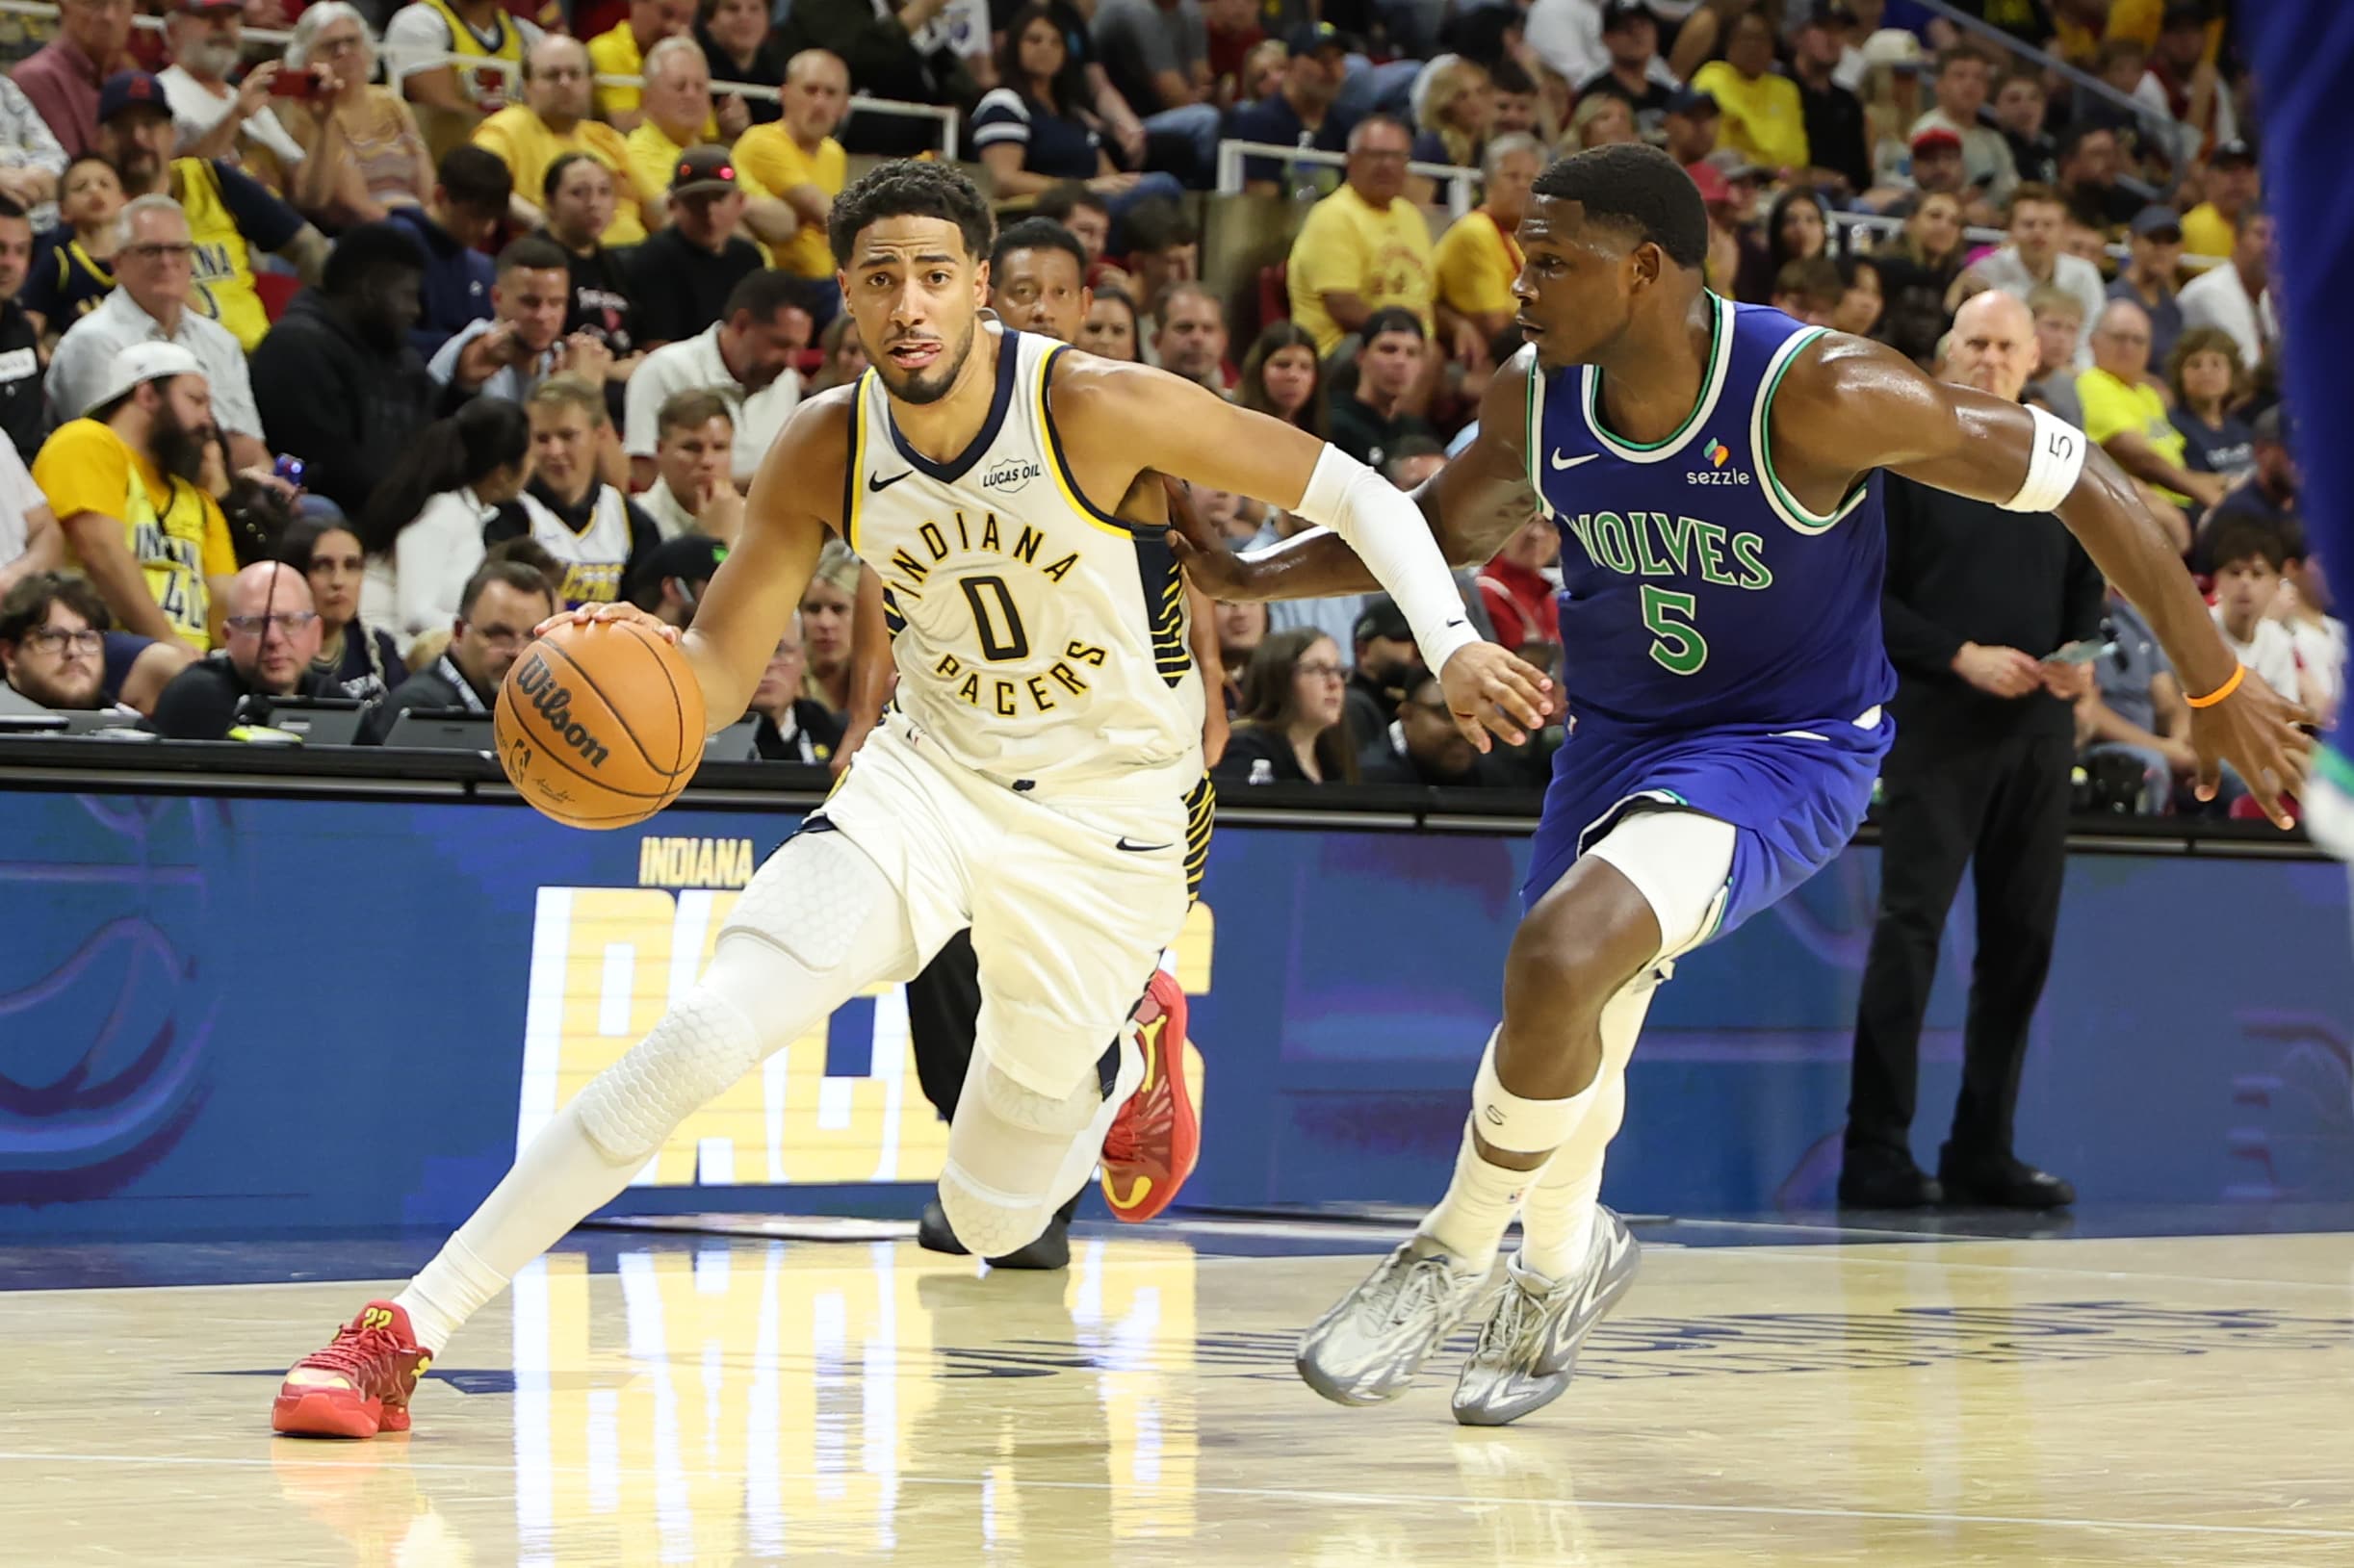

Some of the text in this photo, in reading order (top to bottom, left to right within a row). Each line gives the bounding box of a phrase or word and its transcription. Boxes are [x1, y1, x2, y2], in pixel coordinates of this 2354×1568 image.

[983, 463, 1041, 487] LUCAS OIL
[1686, 467, 1750, 485] sezzle
[2048, 431, 2074, 462] 5
[892, 511, 1079, 600] INDIANA
[1560, 511, 1773, 590] WOLVES
[959, 576, 1029, 662] 0
[1640, 583, 1708, 676] 5
[516, 652, 609, 769] Wilson
[935, 640, 1107, 716] PACERS
[638, 835, 754, 887] INDIANA
